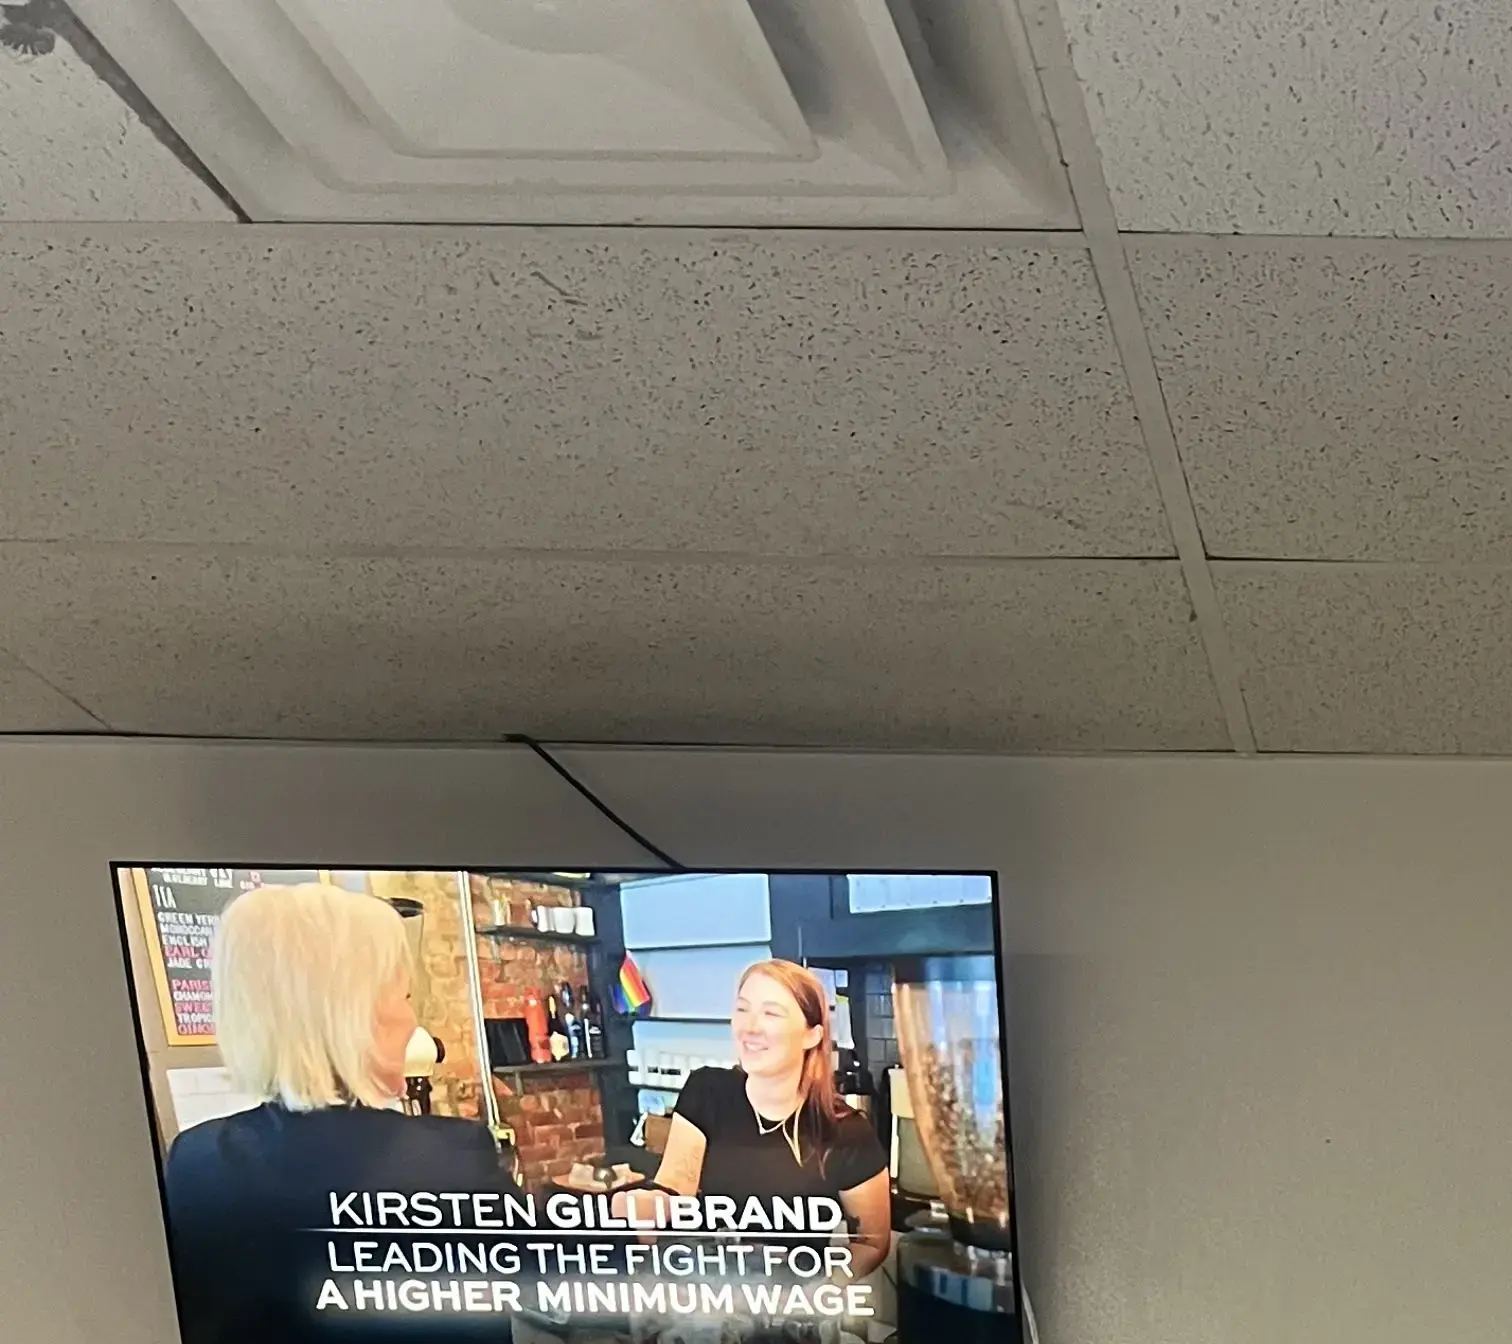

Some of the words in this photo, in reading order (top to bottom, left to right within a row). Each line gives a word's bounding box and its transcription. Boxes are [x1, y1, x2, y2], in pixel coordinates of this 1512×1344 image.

[329, 1191, 537, 1228] KIRSTEN
[546, 1193, 843, 1231] GILLIBRAND
[328, 1241, 521, 1275] LEADING
[526, 1243, 618, 1275] THE
[625, 1244, 754, 1277] FIGHT
[763, 1245, 854, 1279] FOR
[316, 1279, 349, 1311] A
[353, 1279, 523, 1313] HIGHER
[536, 1281, 734, 1315] MINIMUM
[741, 1284, 875, 1317] WAGE
